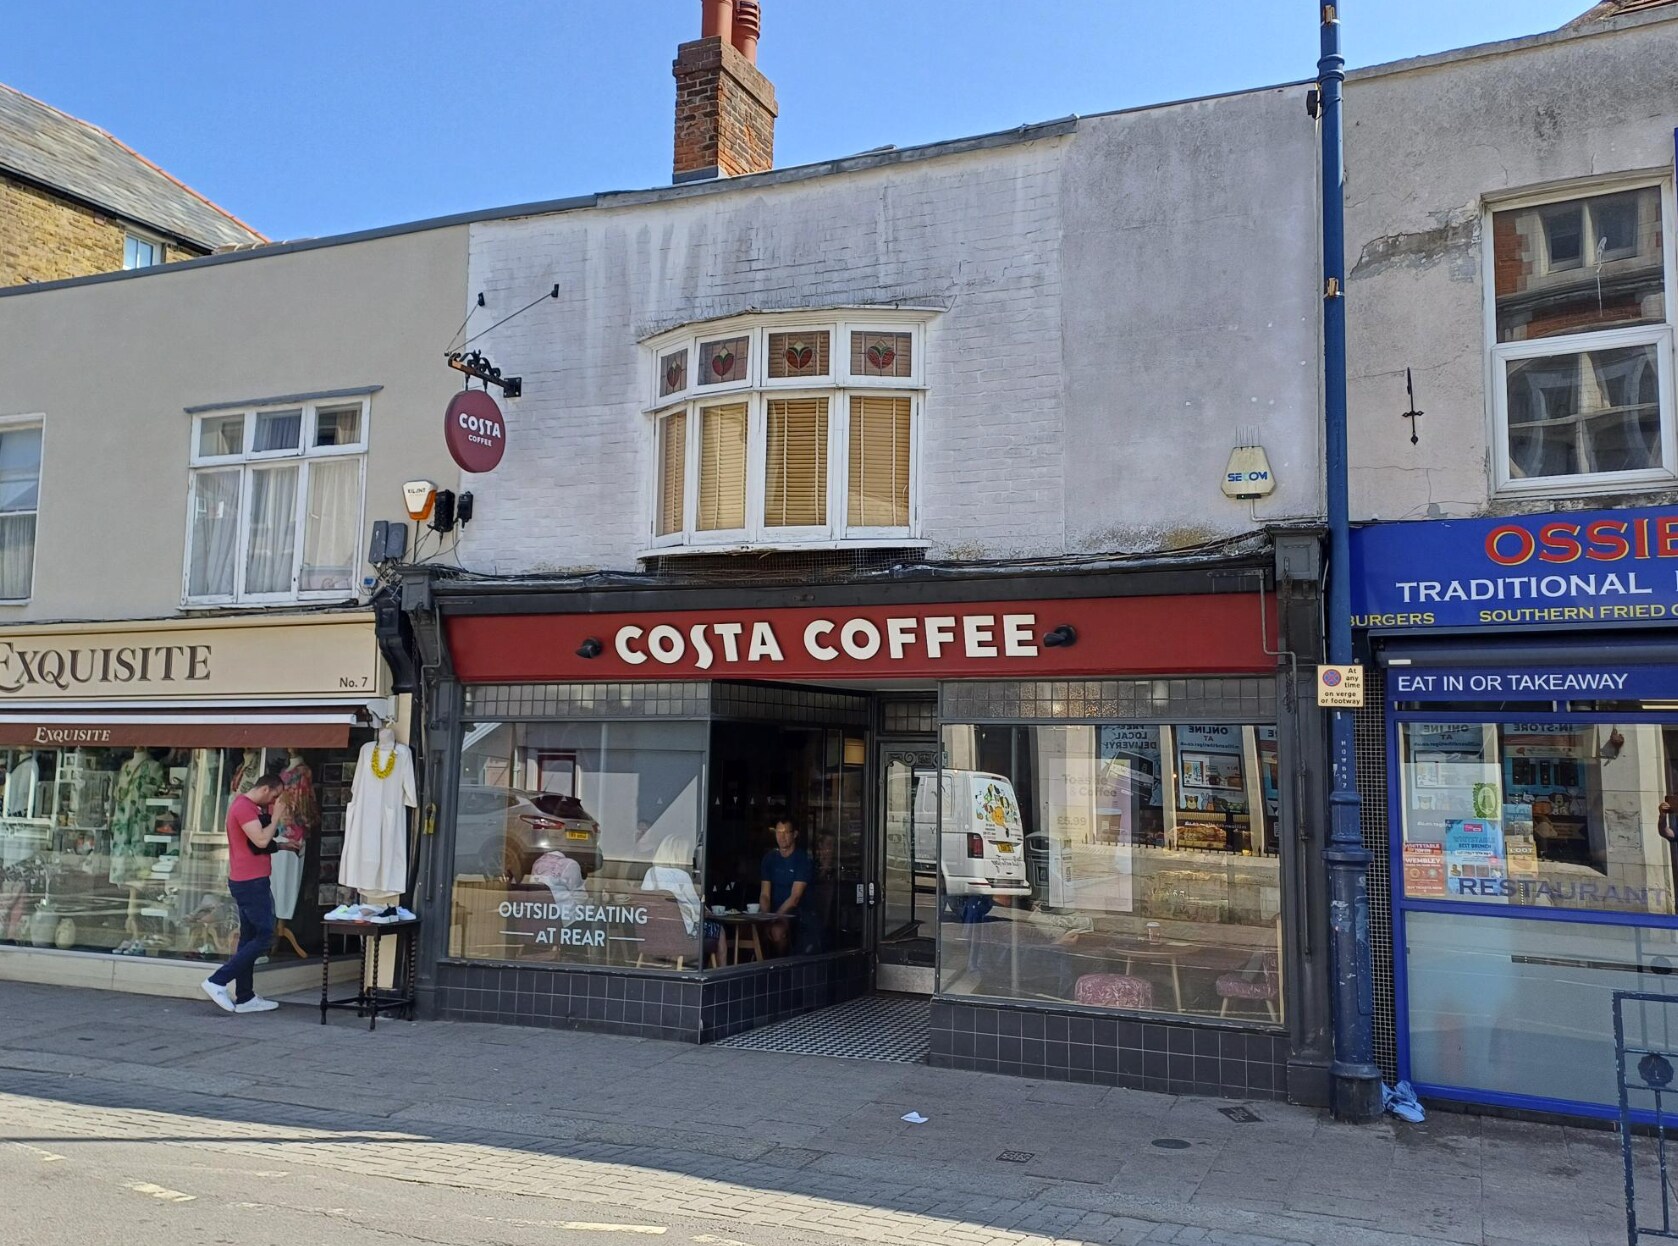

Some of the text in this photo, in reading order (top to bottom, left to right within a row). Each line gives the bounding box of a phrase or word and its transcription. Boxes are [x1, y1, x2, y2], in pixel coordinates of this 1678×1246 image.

[459, 413, 501, 438] COSTA
[468, 434, 492, 447] COFFEE
[1396, 572, 1652, 603] TRADITIONAL
[1479, 607, 1595, 622] SOUTHERN
[1601, 604, 1666, 618] FRIED
[614, 613, 1039, 670] COSTA COFFEE
[339, 676, 369, 688] No. 7
[1398, 673, 1629, 692] EAT IN OR TAKEAWAY
[33, 726, 111, 743] EXQUISITE
[1458, 878, 1665, 907] RESTAURANT
[498, 901, 648, 924] OUTSIDE SEATING
[535, 929, 606, 948] AT REAR
